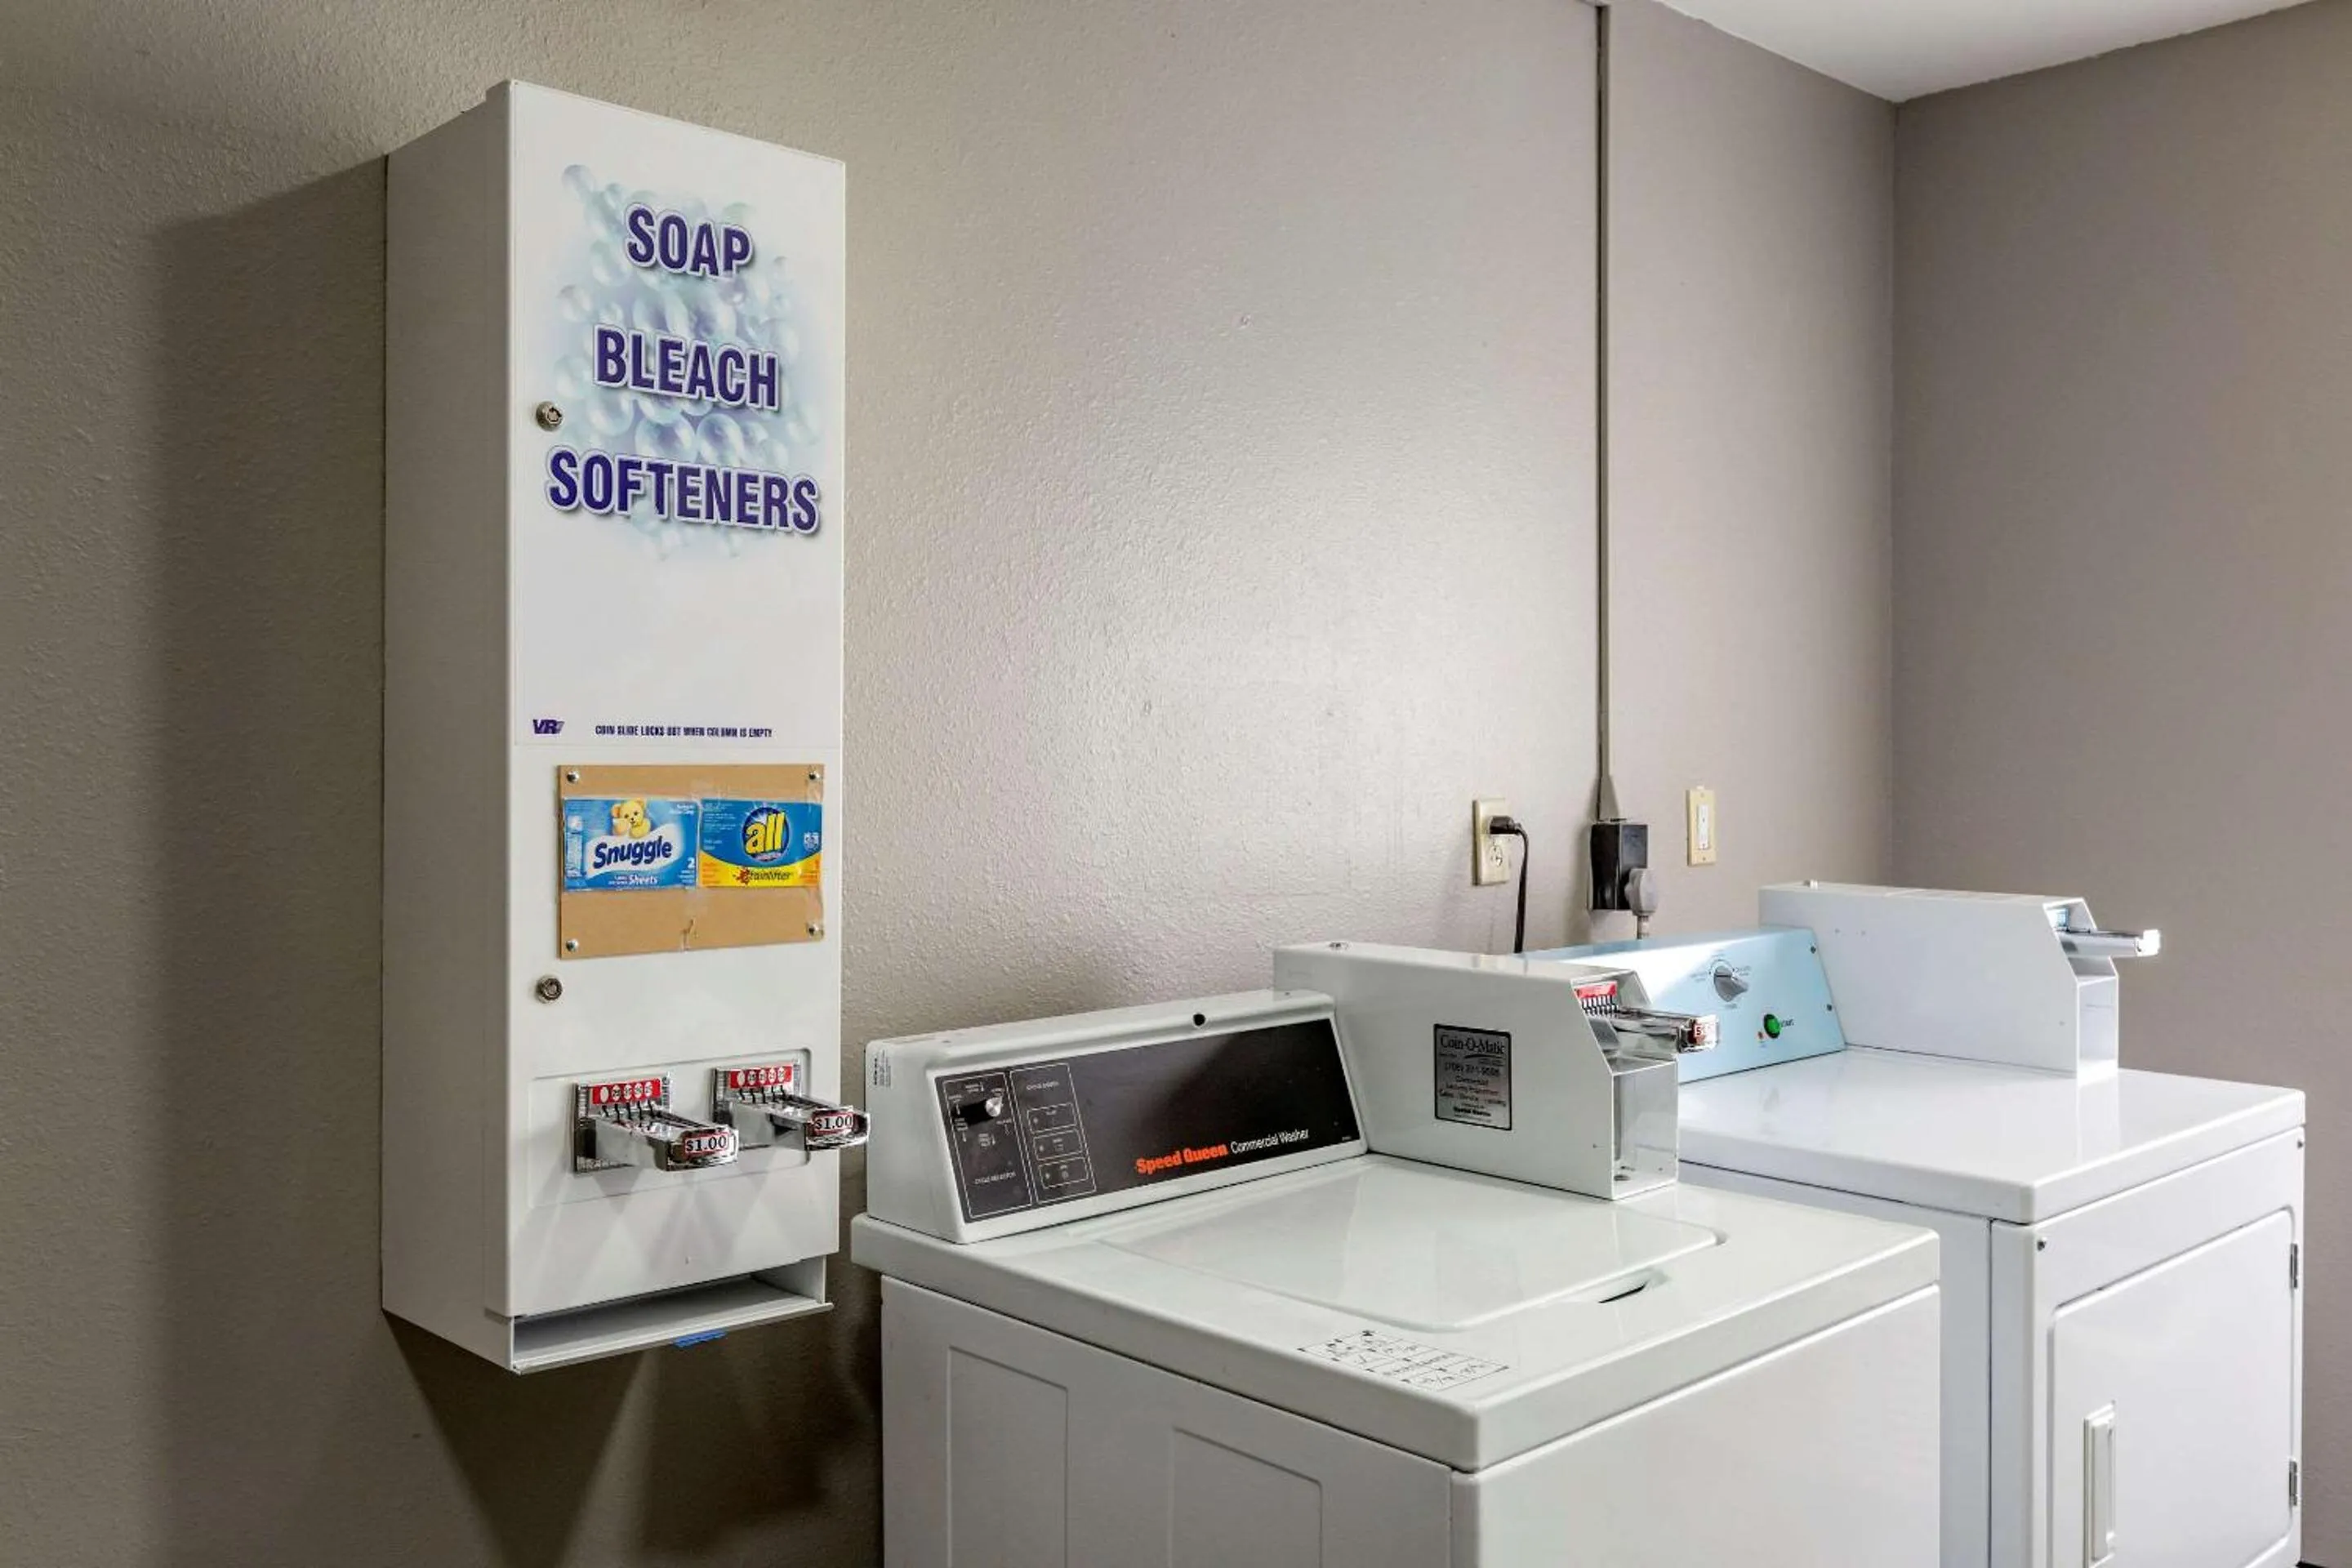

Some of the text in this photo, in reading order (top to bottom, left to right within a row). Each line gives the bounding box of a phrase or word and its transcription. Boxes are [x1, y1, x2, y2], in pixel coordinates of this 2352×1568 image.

[626, 206, 751, 277] SOAP
[595, 327, 777, 408] BLEACH
[549, 449, 817, 532] SOFTENERS
[595, 725, 615, 735] COIN
[617, 725, 639, 736] SLIDE
[640, 725, 664, 737] LOCKS
[683, 727, 705, 737] WHEN
[706, 727, 737, 737] COLUMN
[739, 728, 747, 737] IS
[749, 728, 773, 738] EMPTY
[593, 835, 673, 869] Snuggle
[744, 811, 786, 856] all
[1441, 1035, 1505, 1054] Coin-O-Matic
[814, 1115, 854, 1131] $1.00
[685, 1136, 727, 1152] $1.00
[1135, 1129, 1309, 1174] Speed Queen Commercial Washer
